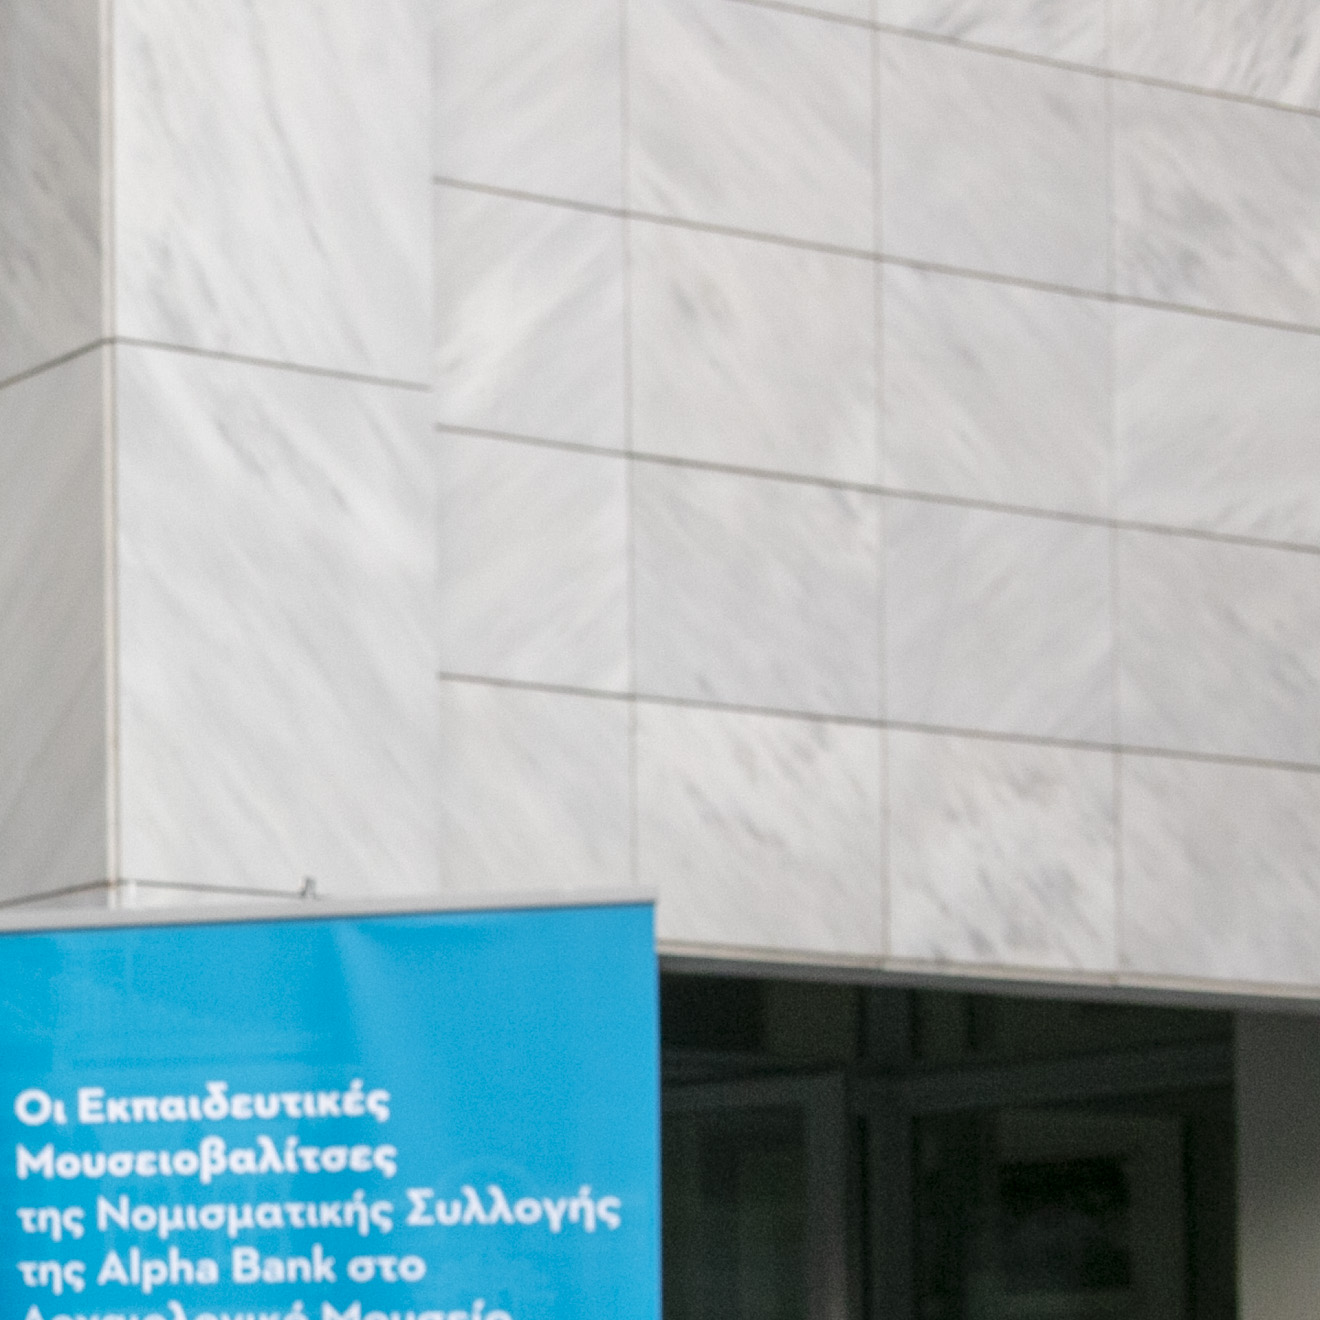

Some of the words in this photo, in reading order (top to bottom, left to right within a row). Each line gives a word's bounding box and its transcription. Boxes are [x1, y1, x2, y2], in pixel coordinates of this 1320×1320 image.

[14, 1088, 68, 1126] Οι
[77, 1079, 390, 1124] Εκπαιδευτικές
[16, 1134, 398, 1185] Μουσειοβαλίτσες
[17, 1206, 85, 1242] της
[96, 1190, 394, 1240] Νομισματικής
[406, 1185, 621, 1232] Συλλογής
[18, 1260, 86, 1295] της
[97, 1246, 220, 1294] Alpha
[231, 1245, 334, 1284] Bank
[347, 1255, 427, 1282] στο
